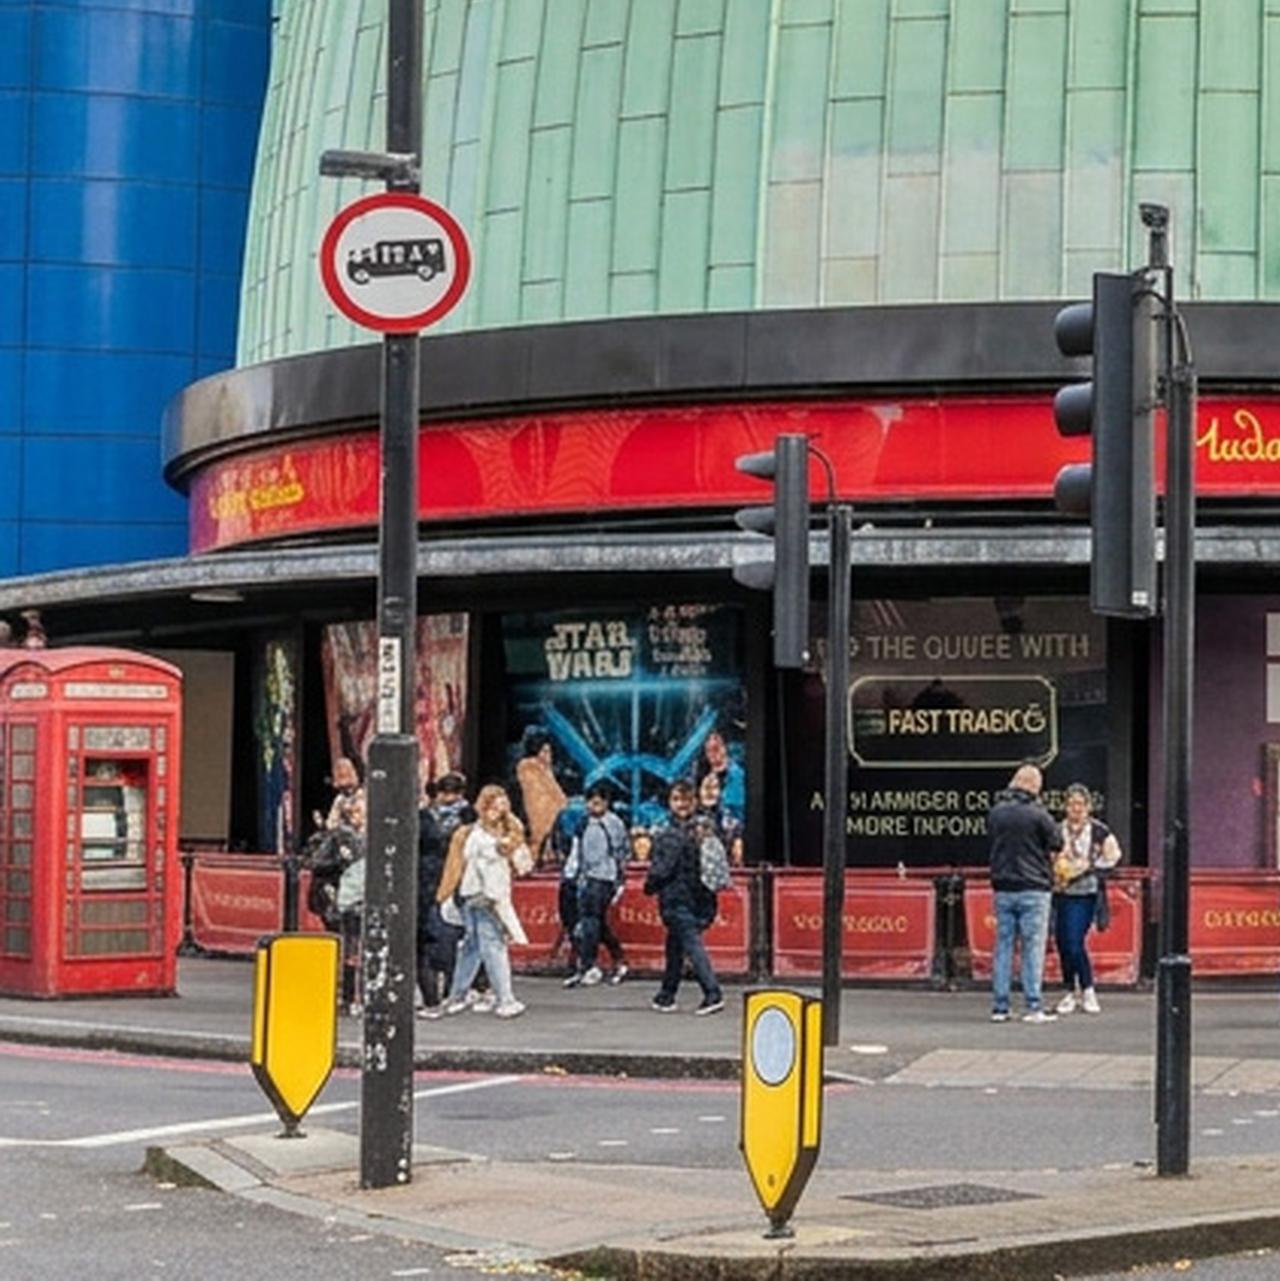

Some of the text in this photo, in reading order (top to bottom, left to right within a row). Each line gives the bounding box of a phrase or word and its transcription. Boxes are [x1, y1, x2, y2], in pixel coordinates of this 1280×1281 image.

[867, 635, 917, 660] THE
[1018, 632, 1091, 659] WITH
[889, 708, 944, 735] FAST
[846, 816, 909, 836] MORE
